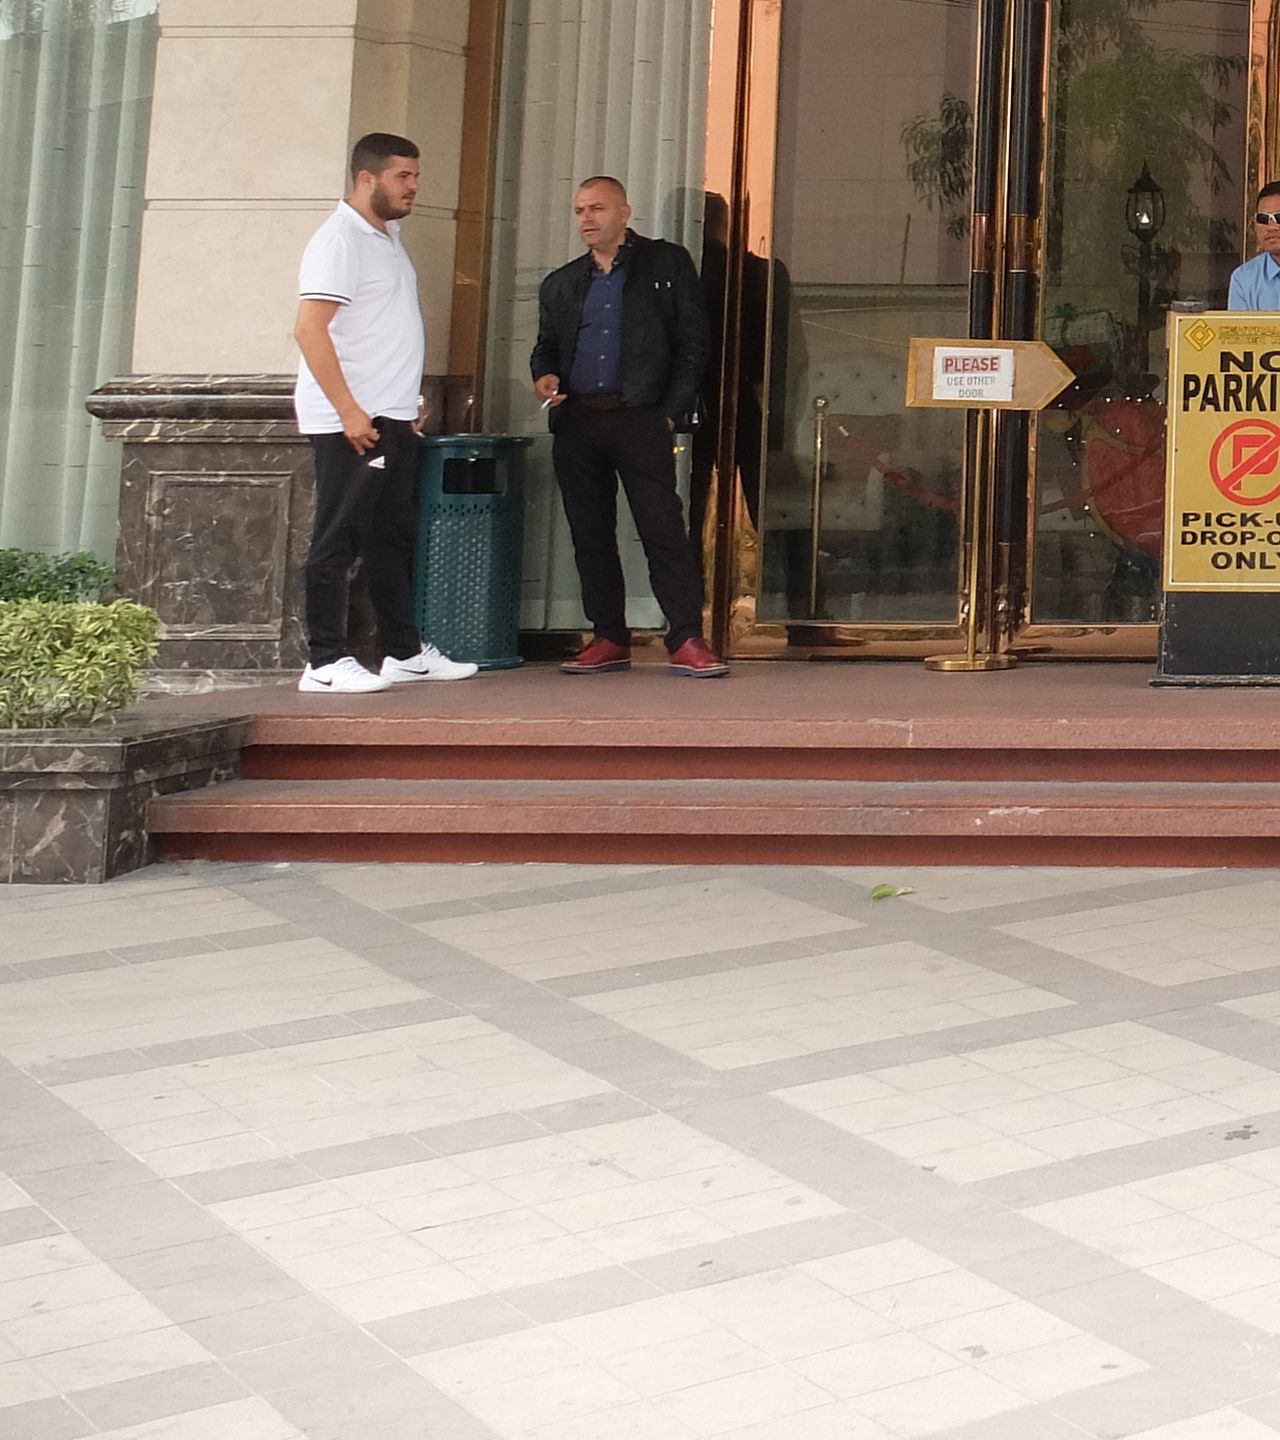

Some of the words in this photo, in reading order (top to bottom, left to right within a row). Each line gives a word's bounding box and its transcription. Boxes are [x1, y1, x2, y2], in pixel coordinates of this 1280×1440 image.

[944, 356, 999, 372] PLEASE
[946, 376, 966, 386] USE
[966, 376, 996, 386] OTHER
[958, 389, 984, 398] DOOR
